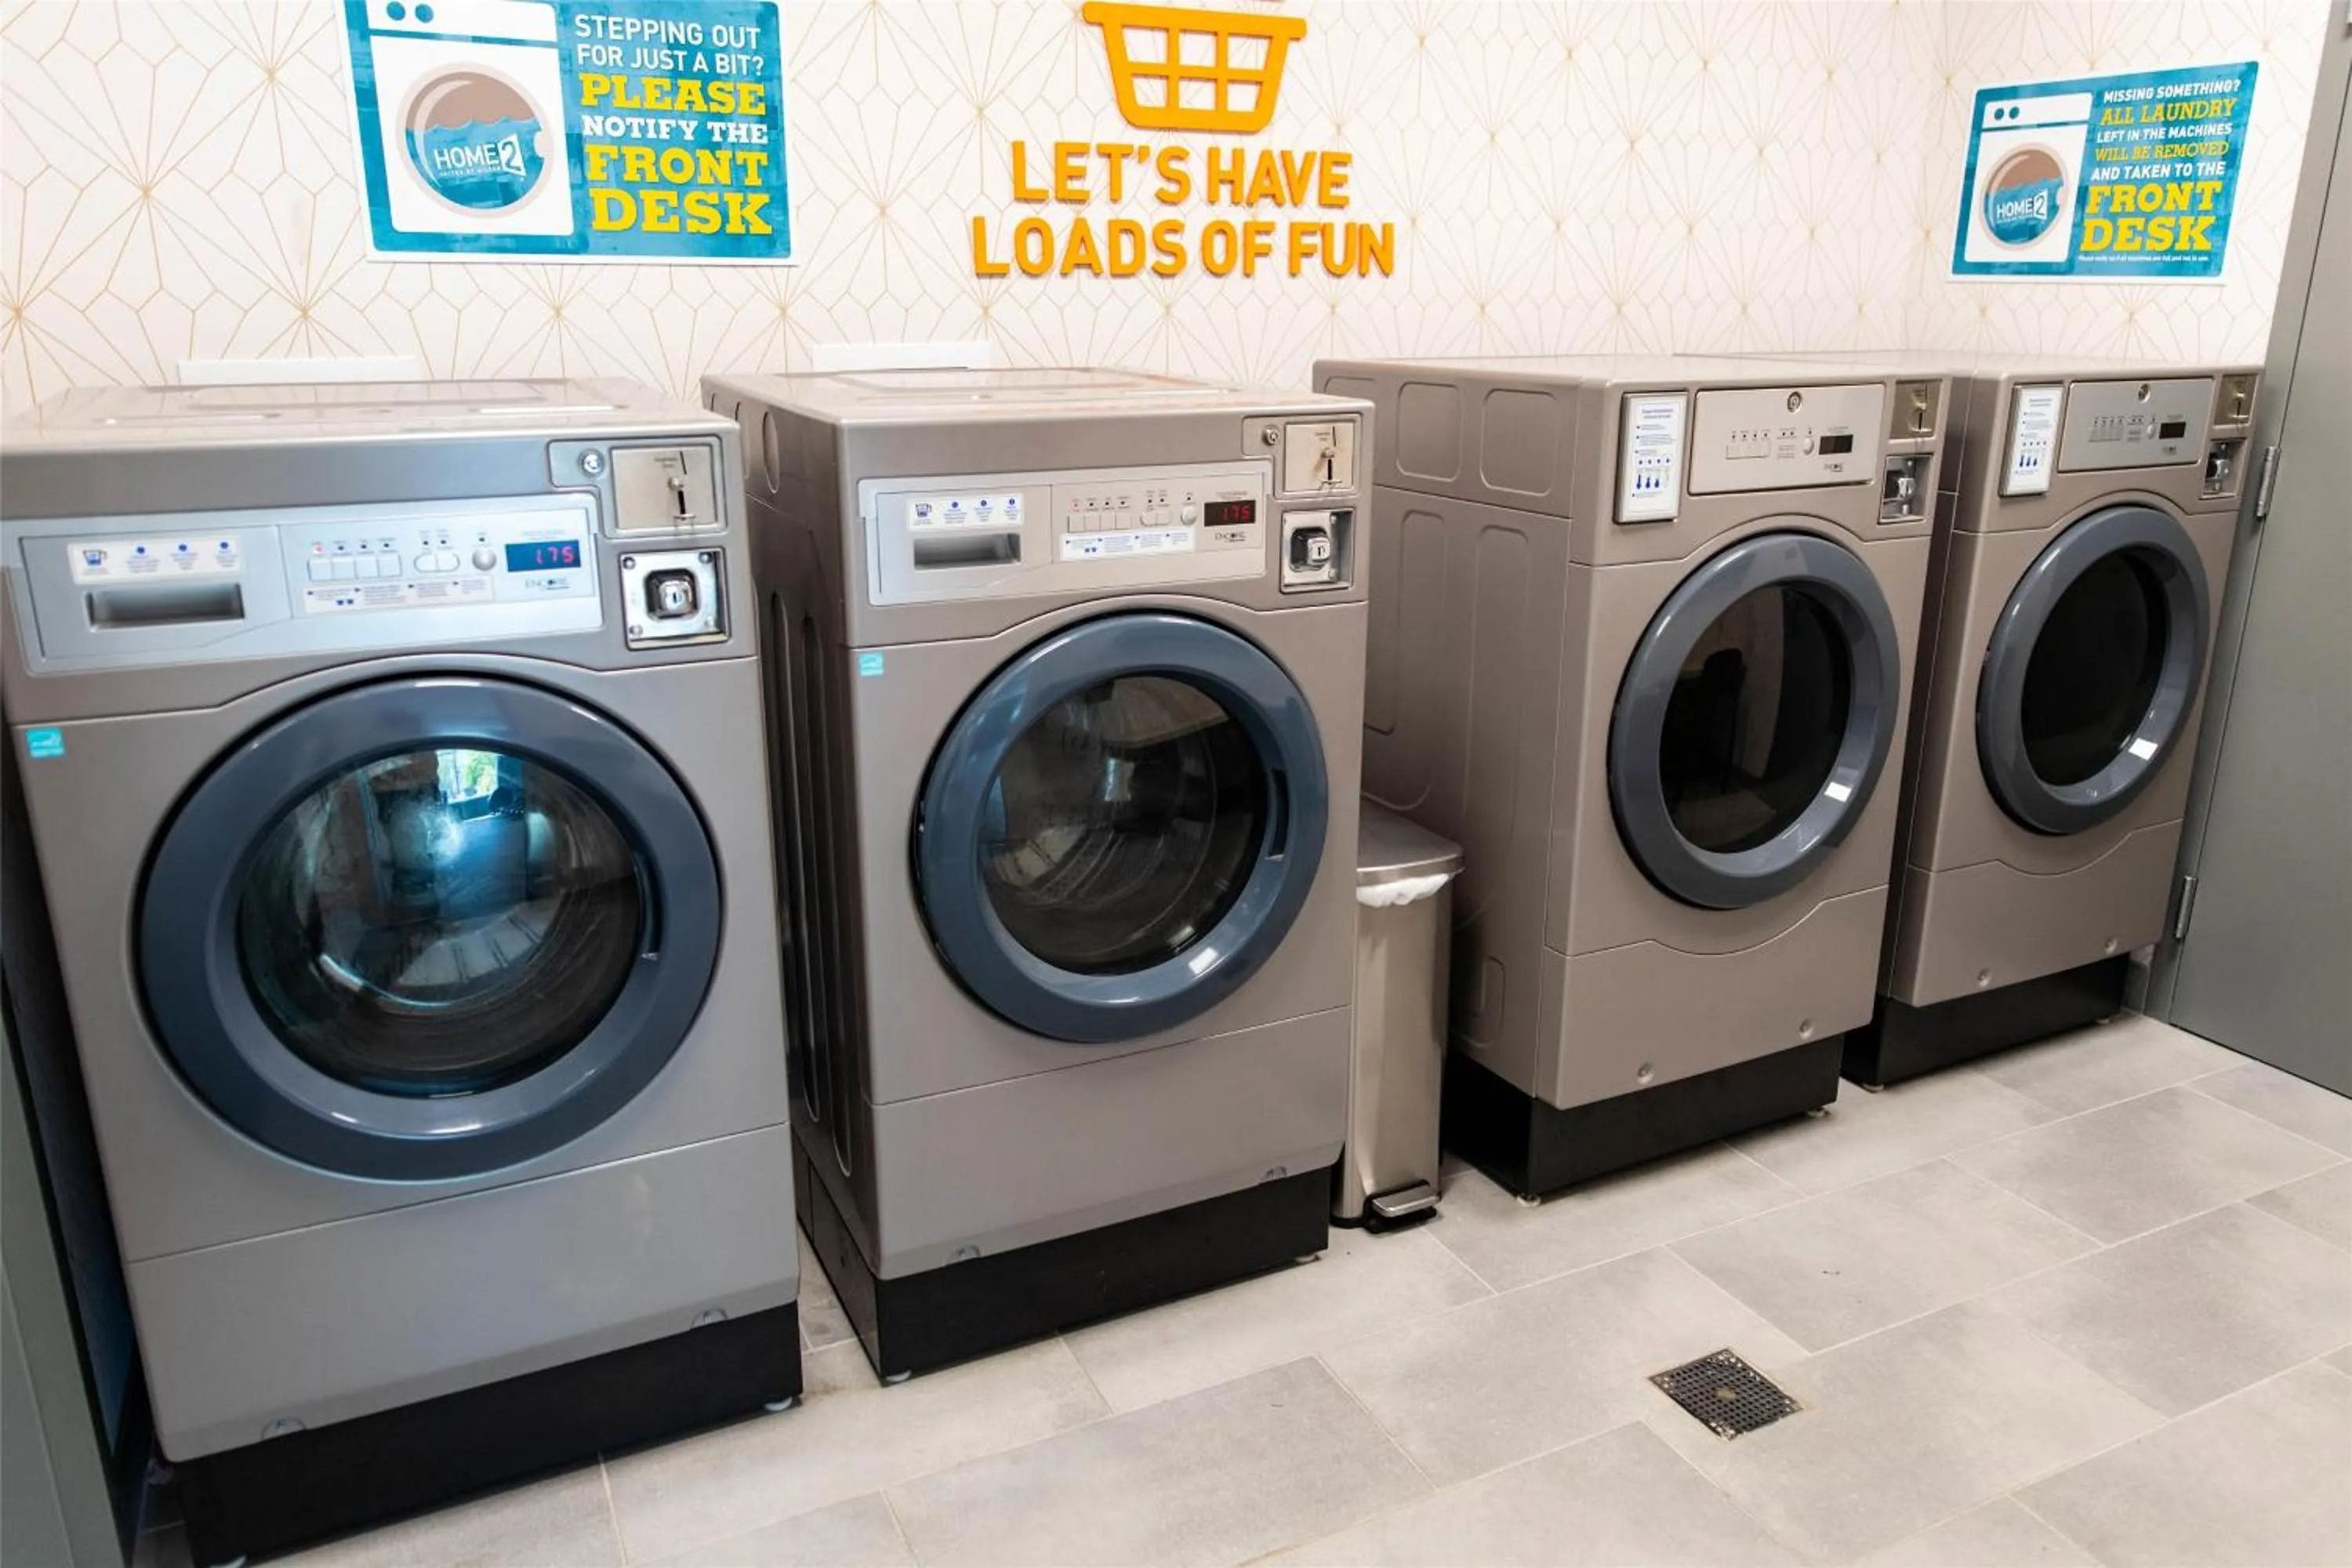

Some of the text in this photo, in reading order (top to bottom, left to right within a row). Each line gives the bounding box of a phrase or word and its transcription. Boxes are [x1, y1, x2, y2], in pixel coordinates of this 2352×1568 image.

[575, 14, 760, 49] STEPPING OUT
[577, 44, 764, 76] FOR JUST A BIT?
[579, 73, 766, 115] PLEASE
[2103, 79, 2241, 103] MISSING SOMETHING?
[581, 114, 768, 144] NOTIFY THE
[2100, 98, 2238, 126] ALL LAUNDRY
[2096, 123, 2233, 143] LEFT IN THE MACHINES
[584, 143, 768, 186] FRONT
[2096, 140, 2229, 162] WILL BE REMOVED
[1011, 140, 1352, 208] LET'S HAVE
[2091, 161, 2226, 180] AND TAKEN TO THE
[590, 188, 773, 234] DESK
[2085, 180, 2222, 214] FRONT
[972, 216, 1394, 278] LOADS OF FUN
[2080, 216, 2217, 252] DESK
